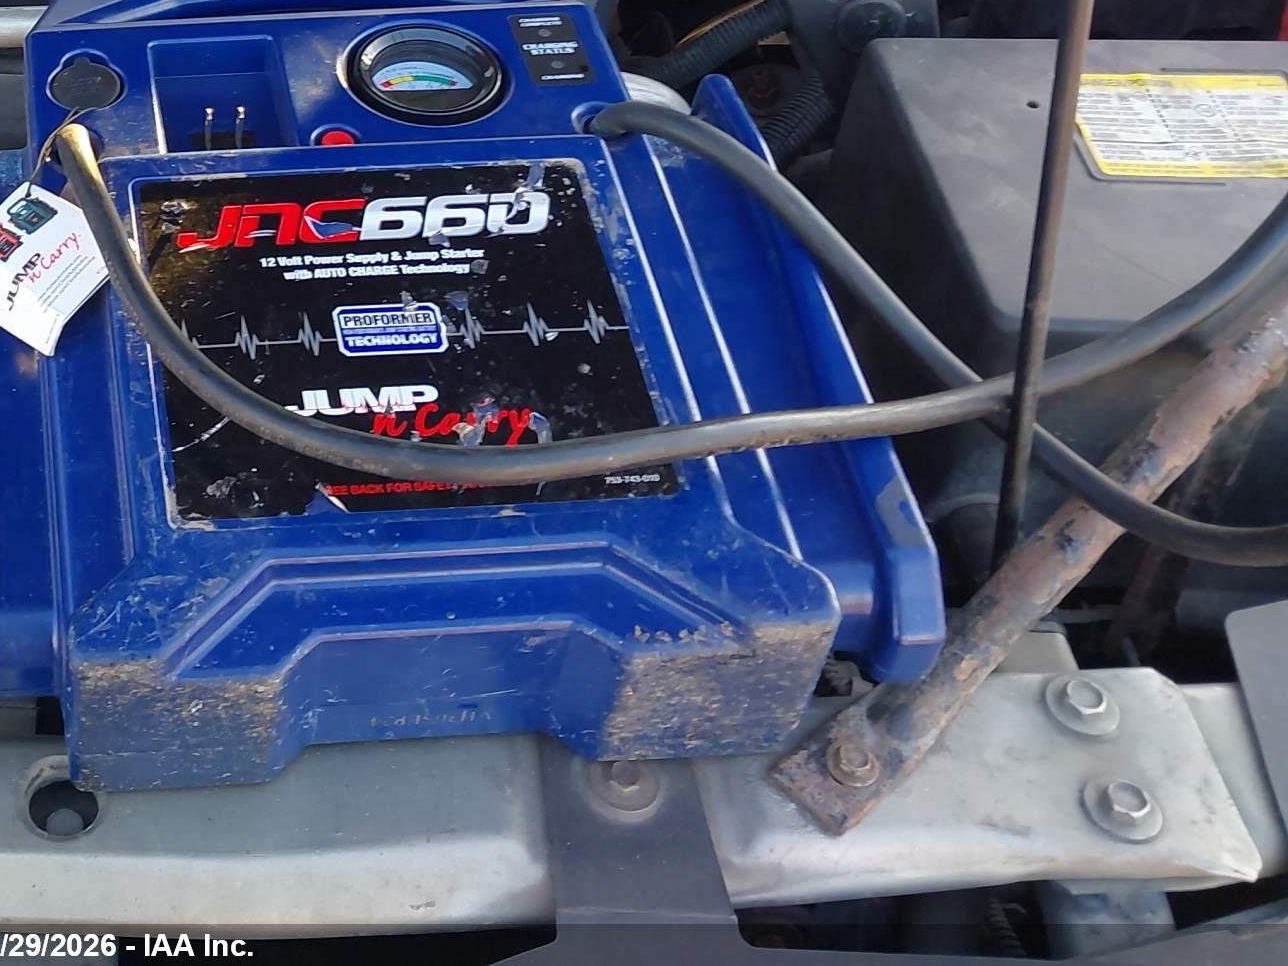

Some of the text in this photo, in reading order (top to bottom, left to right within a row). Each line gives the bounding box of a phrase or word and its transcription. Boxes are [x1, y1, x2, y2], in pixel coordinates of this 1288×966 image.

[176, 191, 552, 254] JNC660
[40, 232, 79, 270] Carry
[259, 247, 485, 268] 12 Volt Power Supply & Jump Starter
[283, 262, 471, 280] with AUTO CHARGE Technology
[6, 253, 41, 311] JUMP
[342, 312, 432, 327] PROFORMER
[344, 332, 438, 347] TECHNOLOGY
[284, 384, 440, 417] JUMP
[350, 483, 385, 496] BACK
[386, 482, 412, 494] FOR
[413, 481, 460, 493] SAFET
